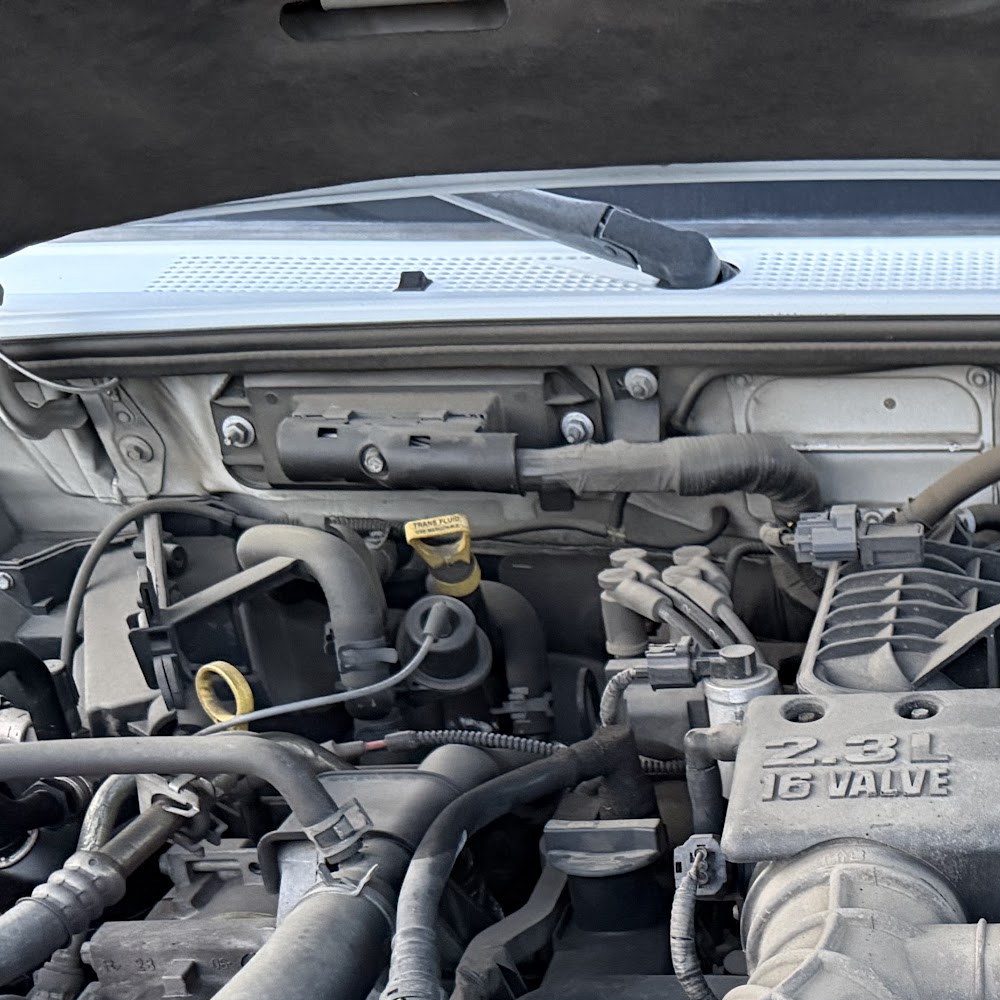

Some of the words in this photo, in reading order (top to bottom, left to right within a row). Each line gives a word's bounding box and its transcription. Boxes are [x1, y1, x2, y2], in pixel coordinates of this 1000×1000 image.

[413, 520, 437, 529] TRANS
[438, 515, 460, 525] FLUID
[762, 731, 950, 768] 2.3L
[760, 771, 815, 802] 16
[828, 767, 950, 799] VALVE
